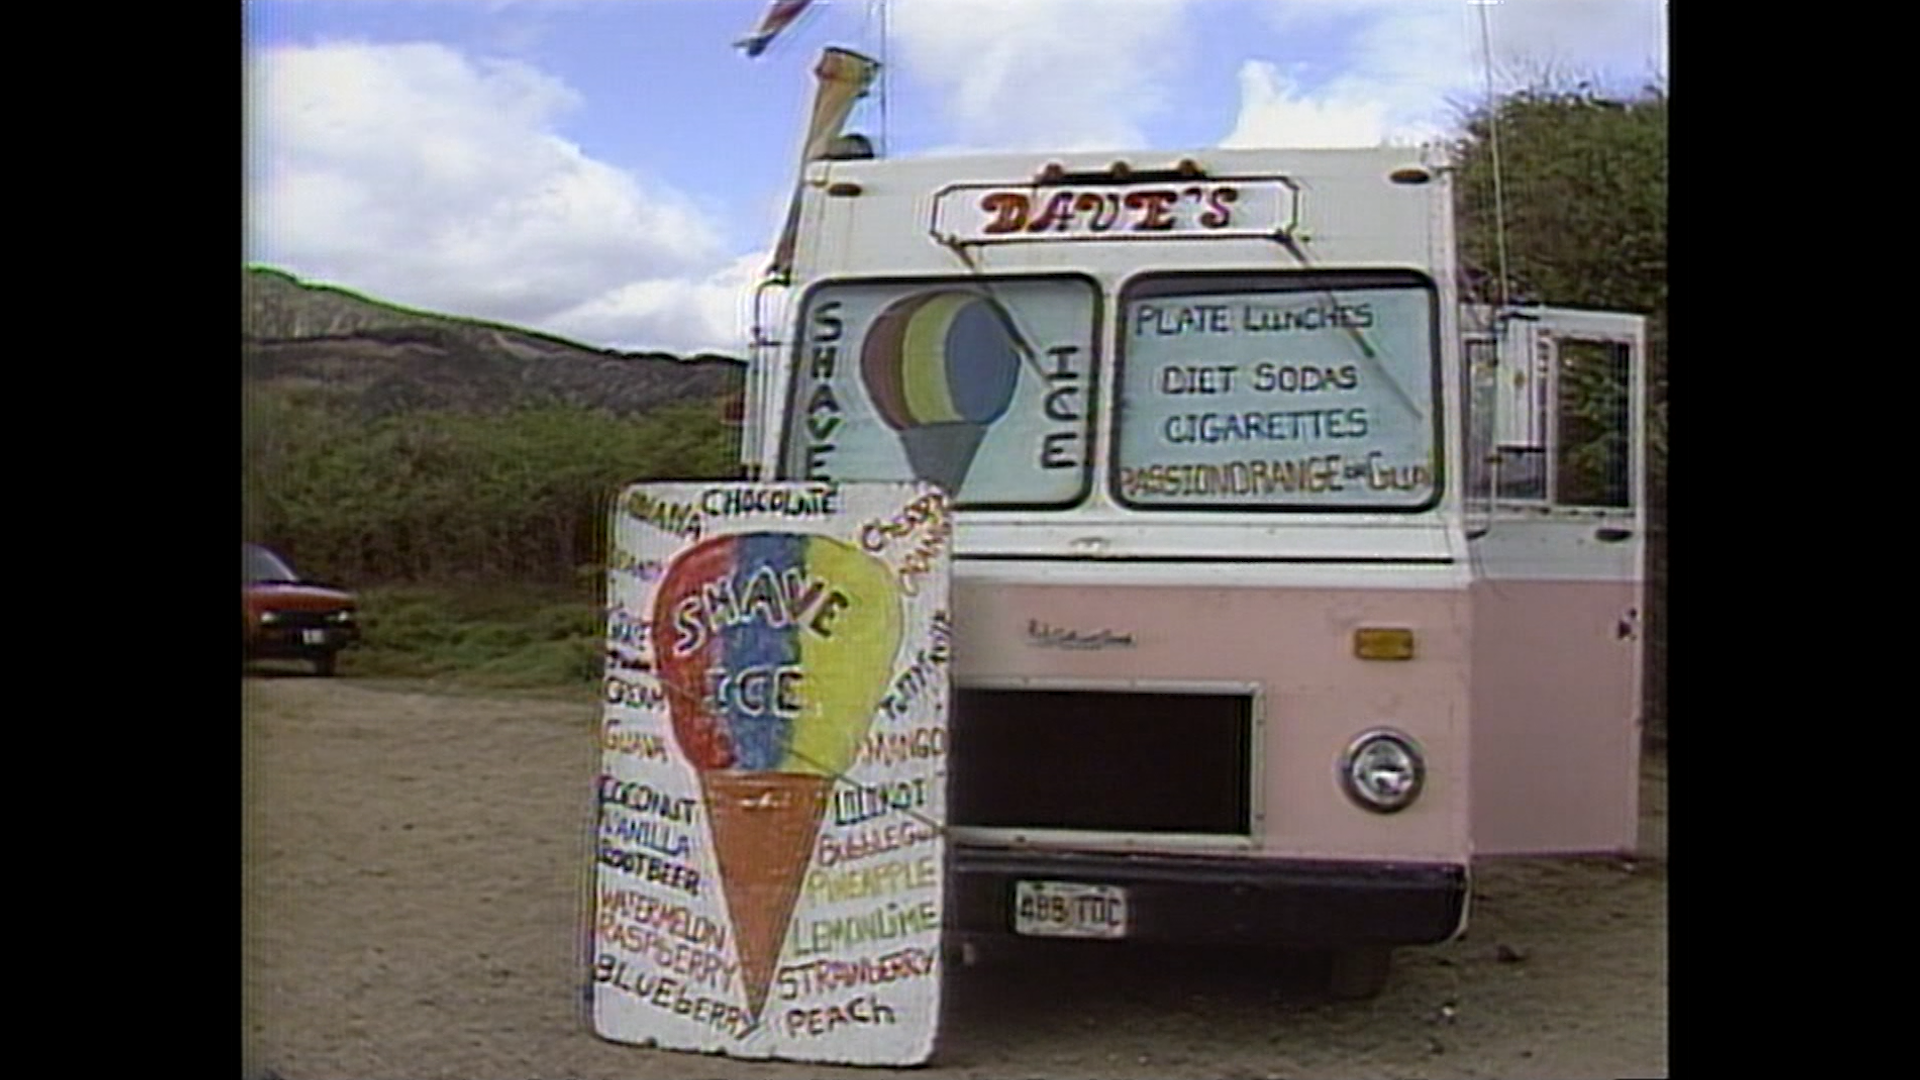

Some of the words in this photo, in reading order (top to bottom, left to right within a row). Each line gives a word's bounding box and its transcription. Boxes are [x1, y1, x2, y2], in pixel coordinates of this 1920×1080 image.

[980, 186, 1239, 234] DAVE'S
[1136, 304, 1229, 335] PLATE
[1162, 366, 1238, 394] DIET
[1254, 363, 1358, 391] SODAS
[1040, 345, 1080, 470] ICE
[1164, 408, 1369, 443] CIGARETTES
[702, 486, 839, 518] CHOCOLATE
[674, 566, 849, 656] SHAVE
[702, 666, 806, 716] ICE
[600, 775, 696, 825] COCONUT
